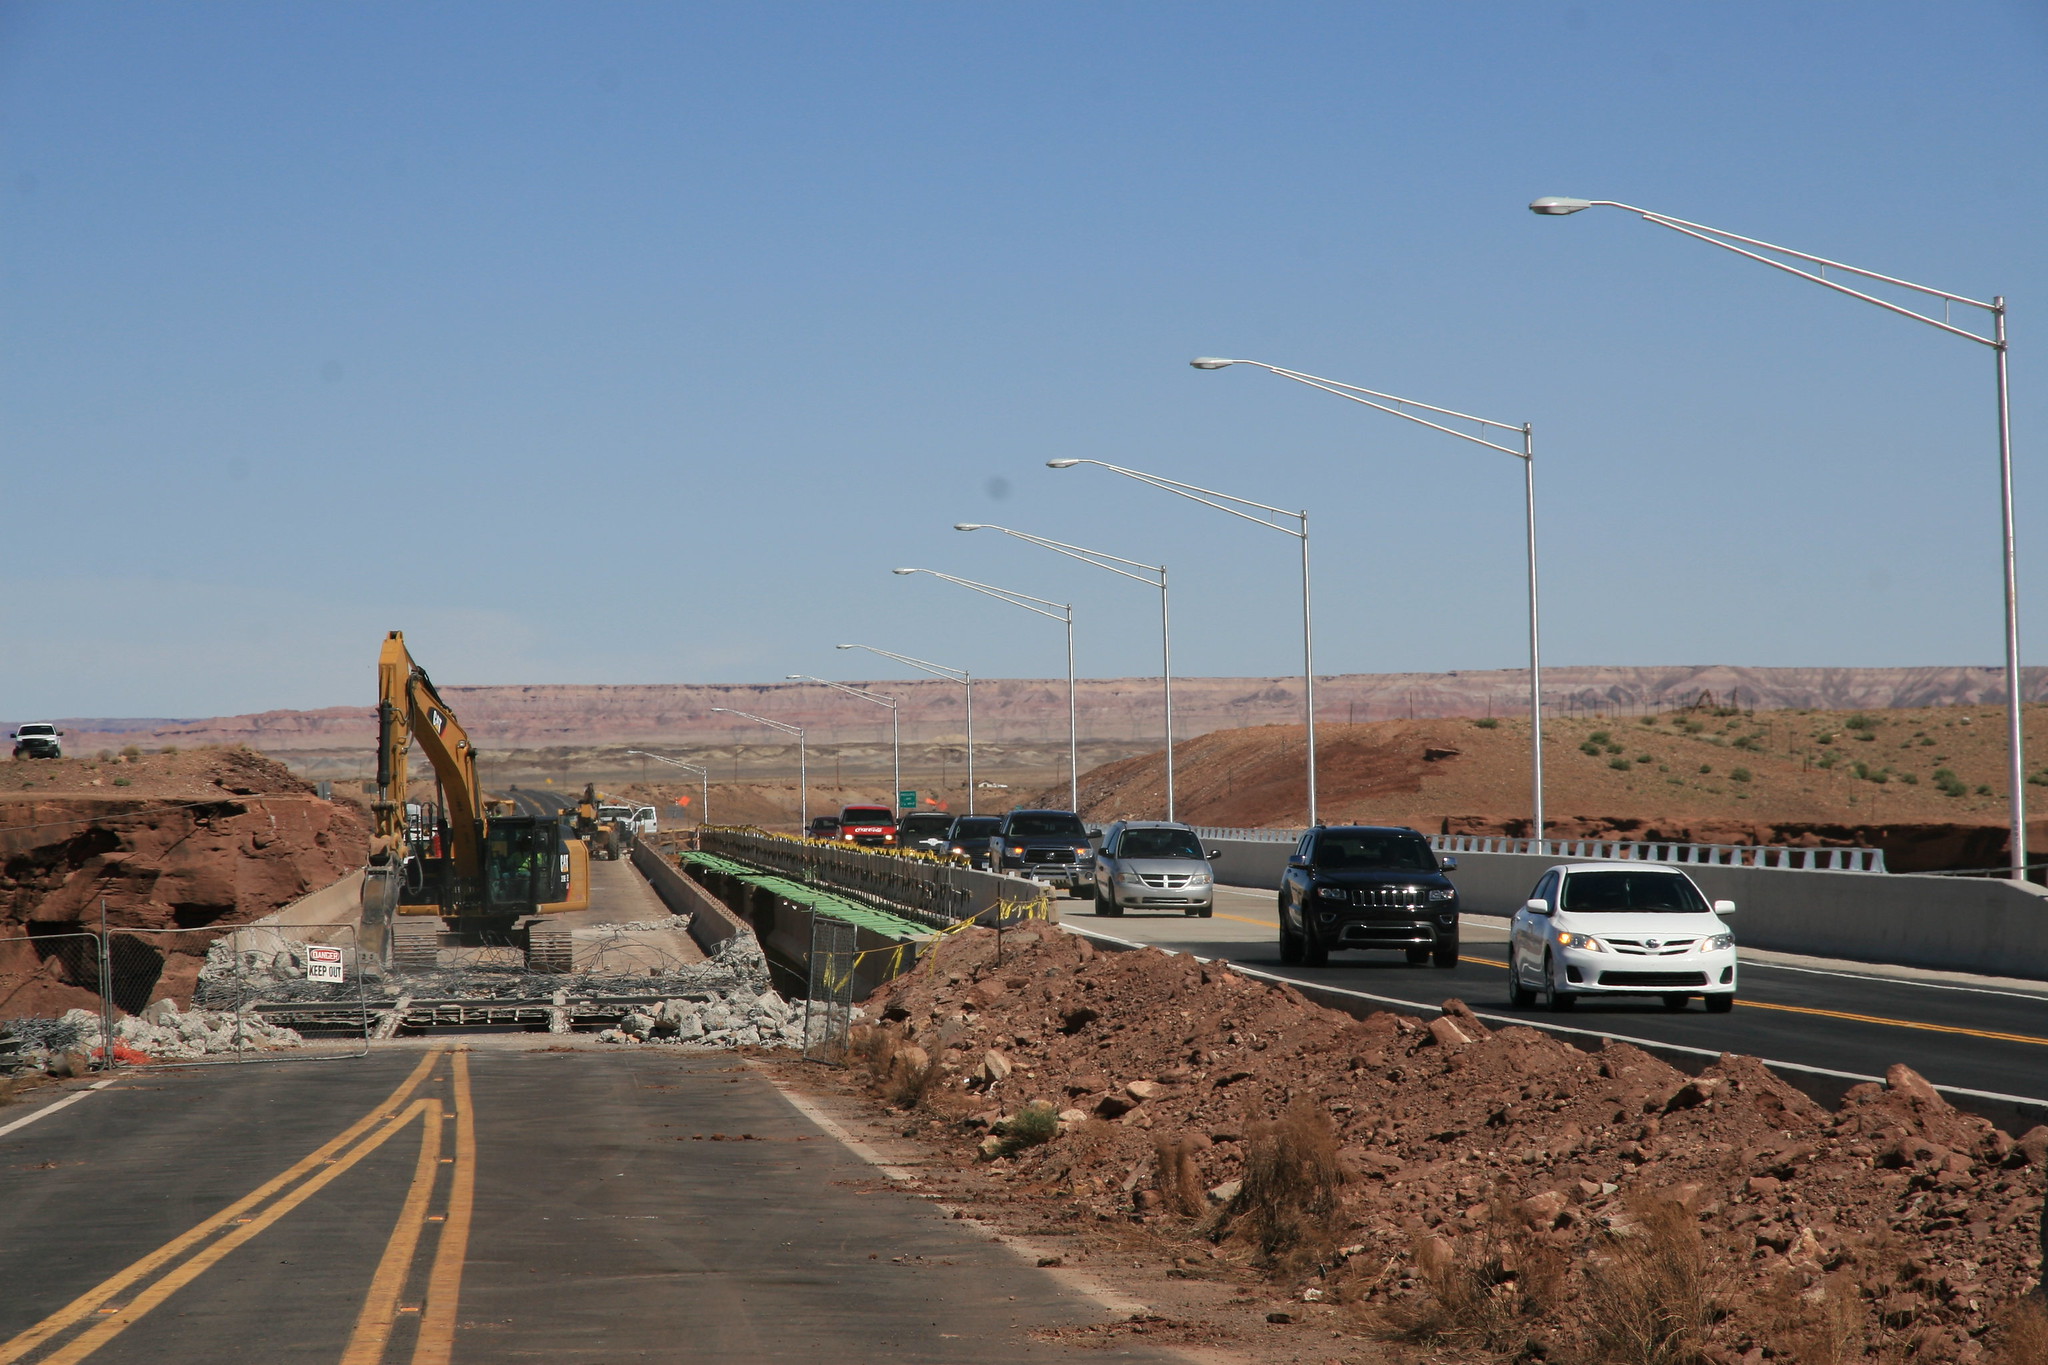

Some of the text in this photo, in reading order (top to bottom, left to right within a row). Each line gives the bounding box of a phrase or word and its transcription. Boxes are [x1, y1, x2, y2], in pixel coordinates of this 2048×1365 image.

[432, 710, 442, 734] CAT
[560, 854, 569, 873] CAT
[313, 951, 339, 960] DANGER
[309, 965, 341, 978] KEEP OUT
